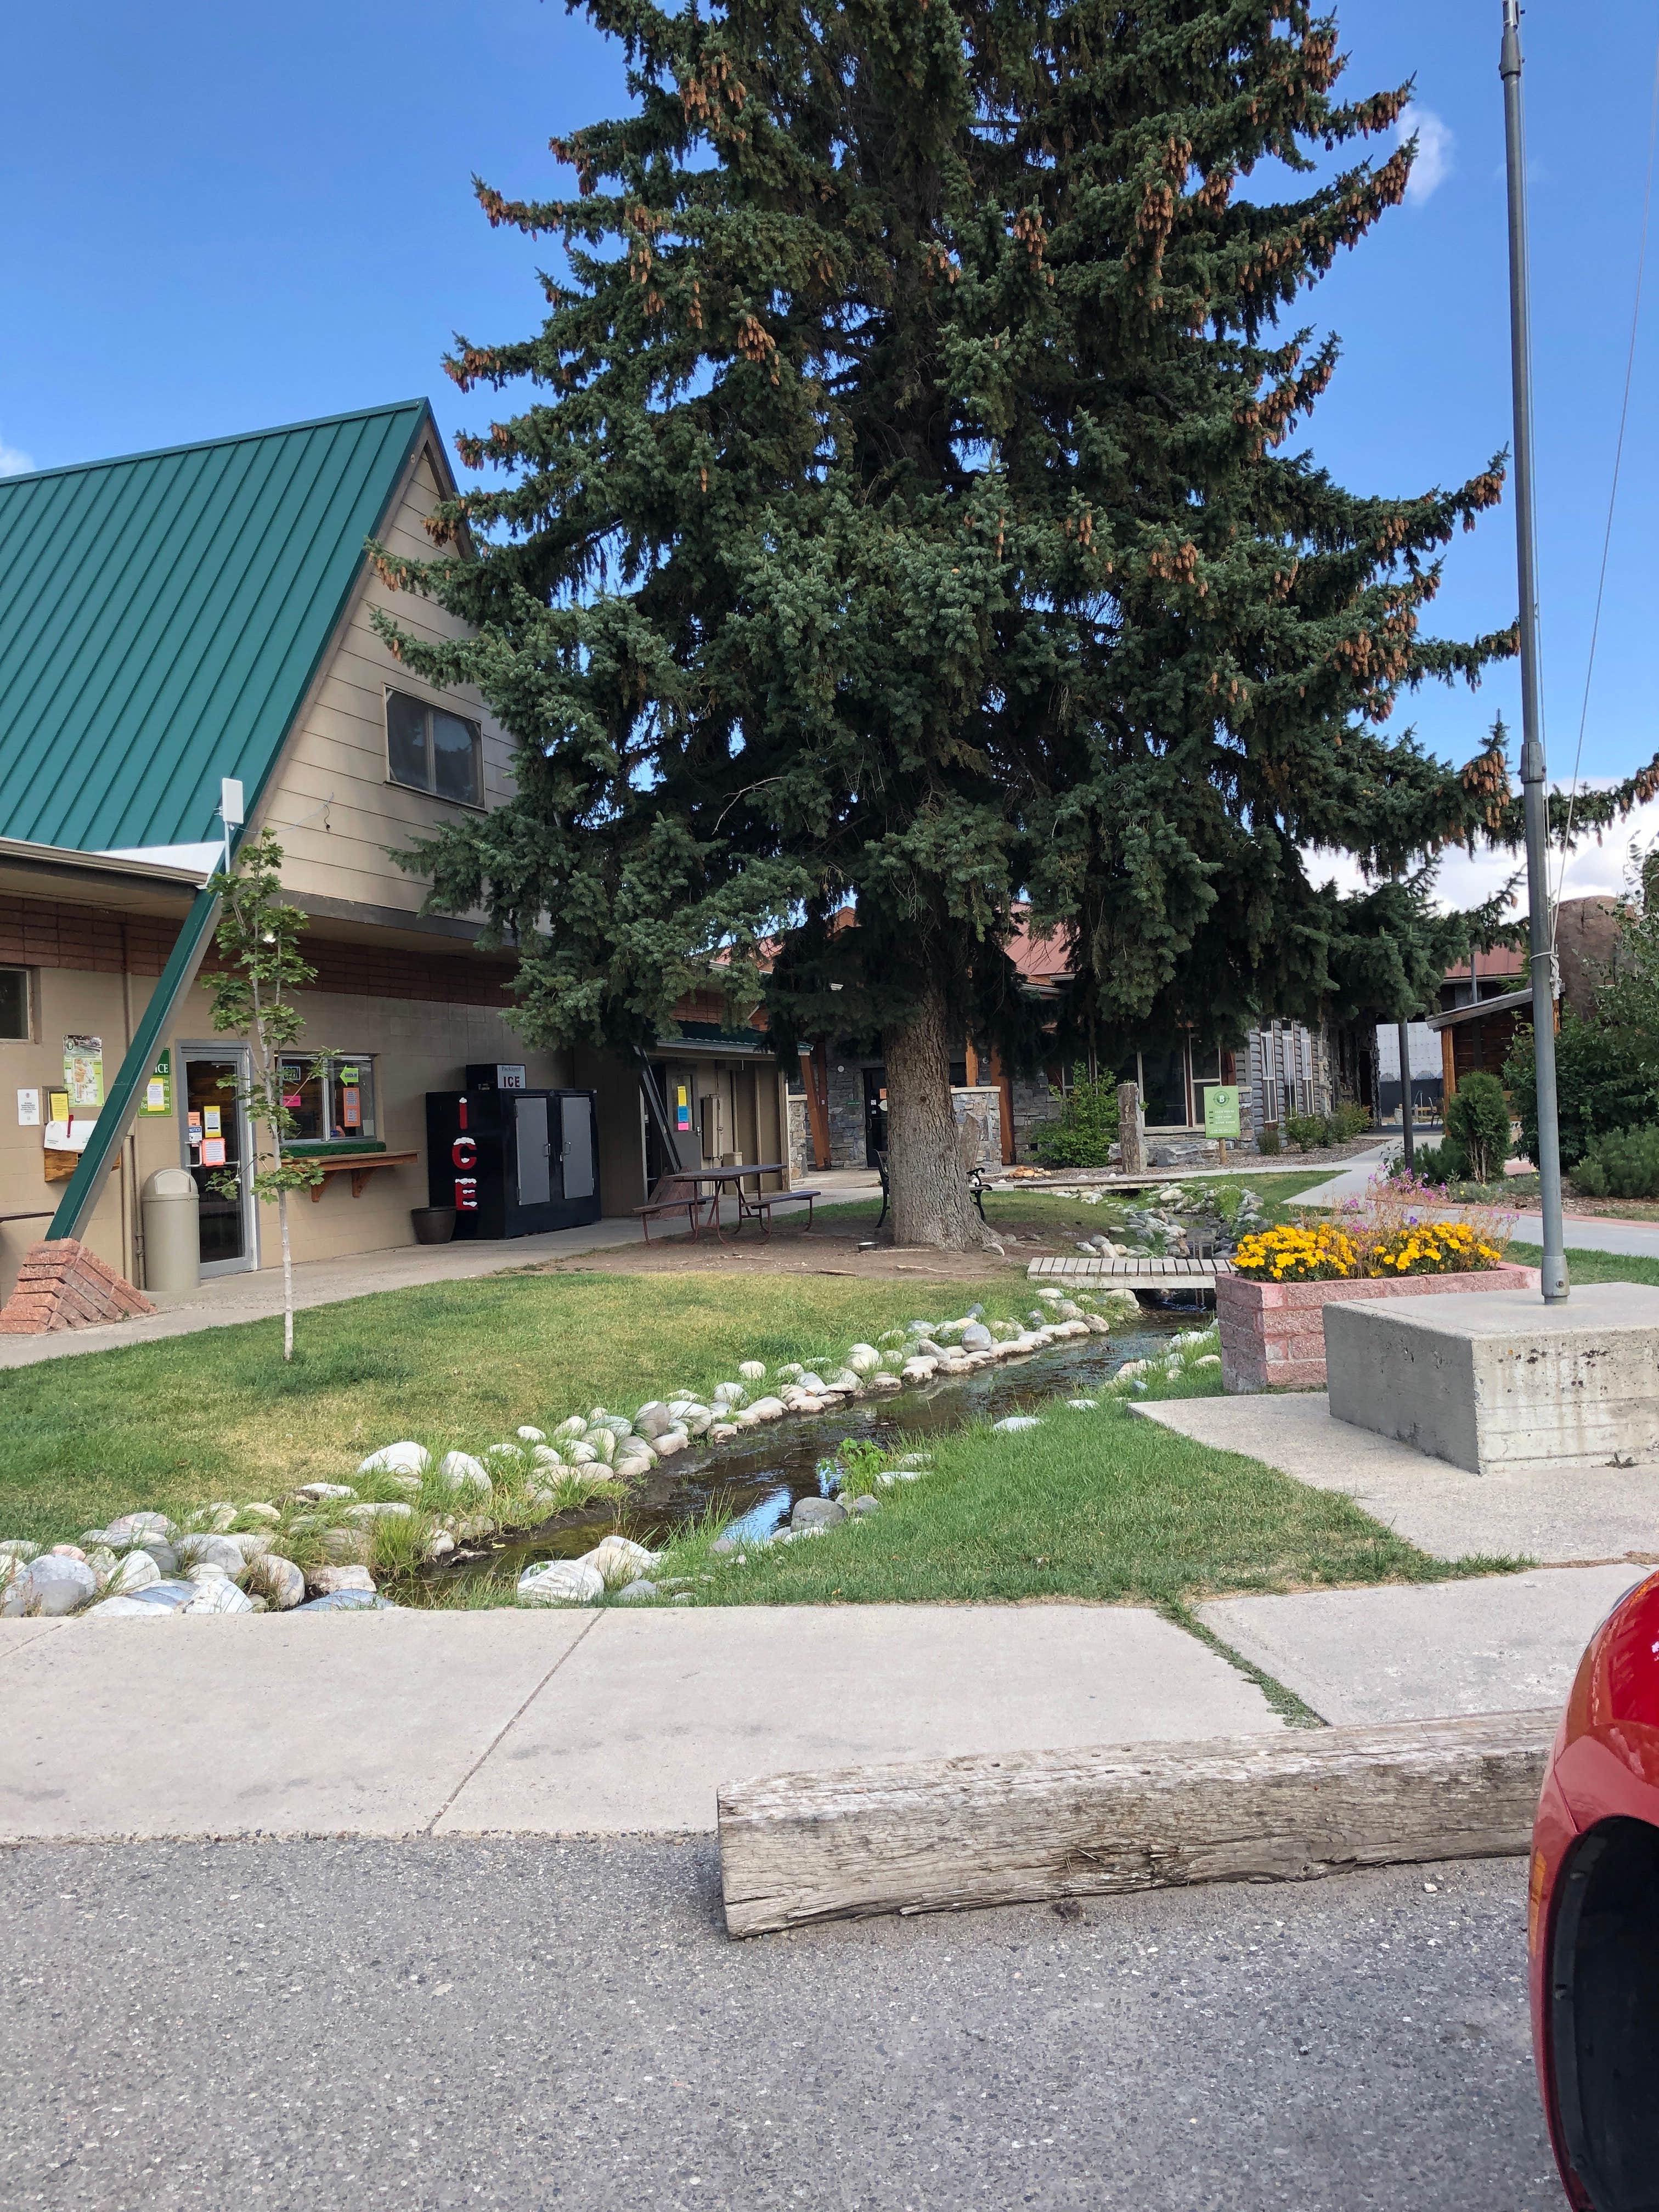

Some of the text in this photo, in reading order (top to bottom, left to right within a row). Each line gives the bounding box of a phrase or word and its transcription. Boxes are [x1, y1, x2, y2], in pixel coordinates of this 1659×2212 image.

[155, 1064, 168, 1073] ICE
[503, 1076, 520, 1087] ICE
[452, 1097, 478, 1210] ICE
